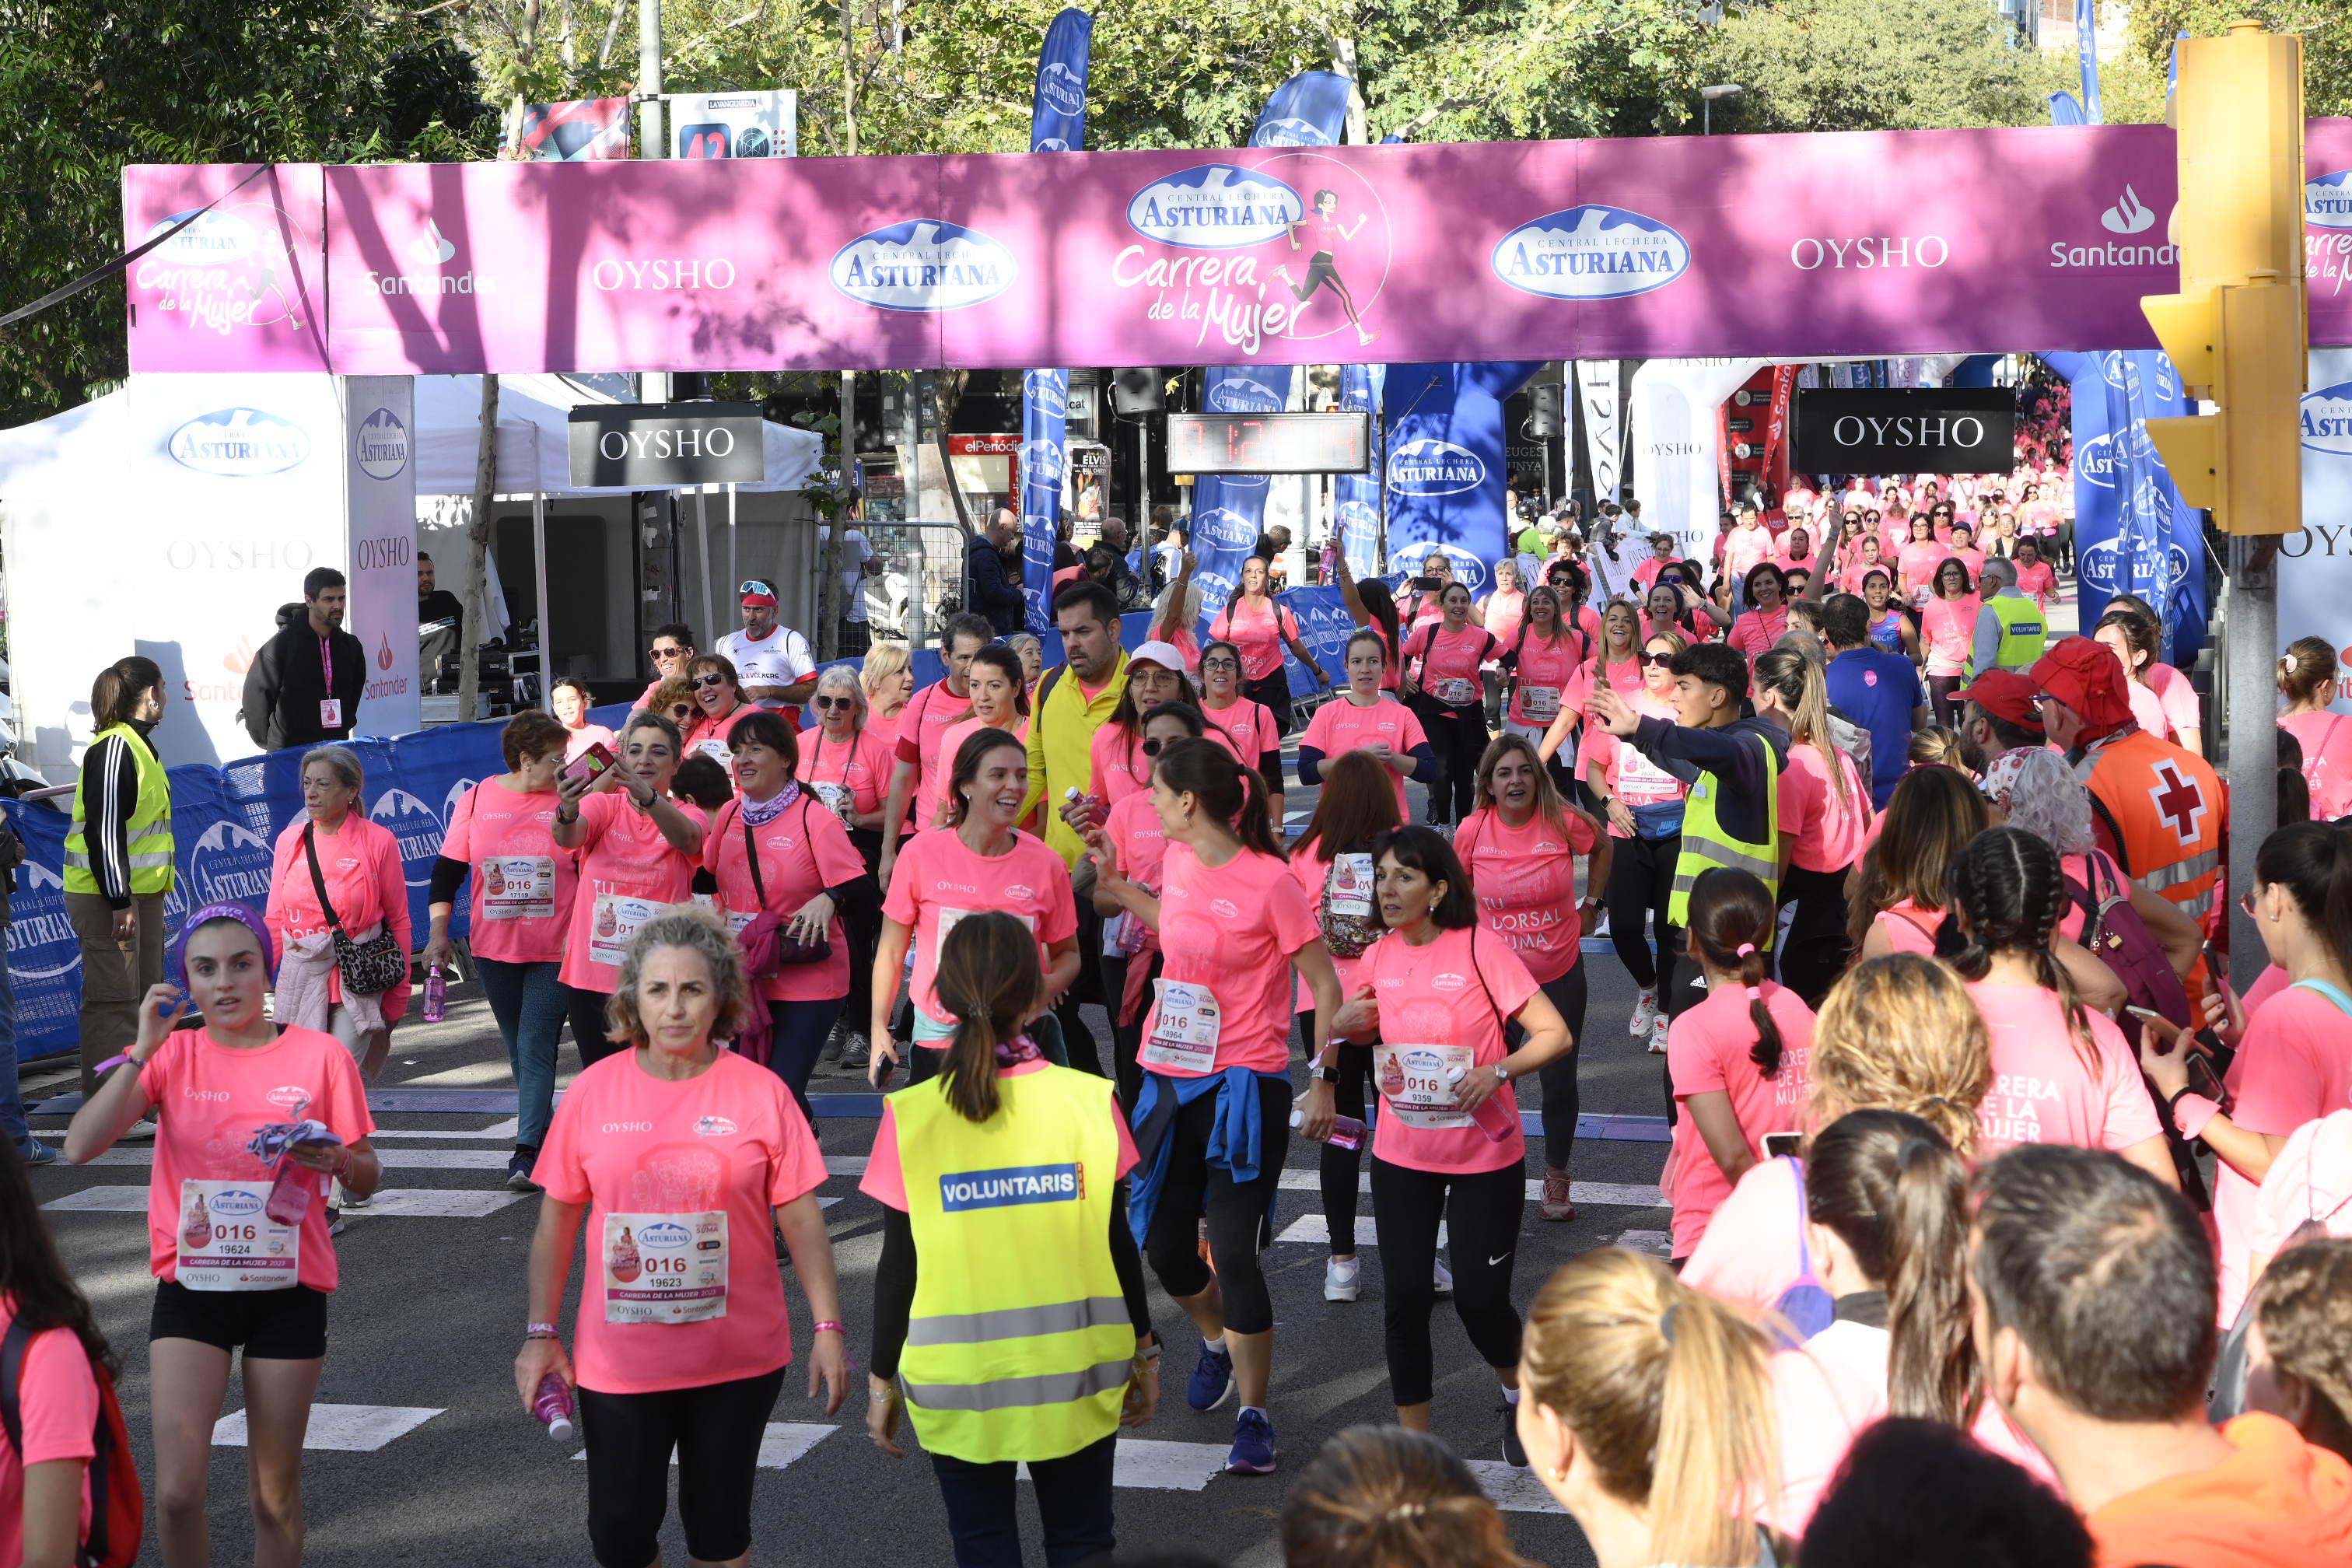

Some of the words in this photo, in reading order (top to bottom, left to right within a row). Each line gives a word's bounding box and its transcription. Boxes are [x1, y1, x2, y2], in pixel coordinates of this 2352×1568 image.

[1167, 193, 1223, 202] CENTRAL
[1229, 192, 1285, 202] LECHERA
[1140, 196, 1290, 228] ASTURIANA
[1538, 238, 1599, 247] CENTRAL
[1605, 236, 1668, 246] LECHERA
[873, 251, 930, 261] CENTRAL
[1507, 241, 1675, 276] ASTURIANA
[1790, 236, 1949, 270] OYSHO
[844, 254, 1001, 289] ASTURIANA
[1112, 244, 1259, 289] Carrera
[2322, 255, 2337, 278] la
[135, 260, 229, 290] Carrera
[593, 258, 736, 291] OYSHO
[365, 269, 497, 296] Santander
[158, 292, 176, 311] de
[179, 290, 192, 312] la
[189, 286, 262, 336] Mujer
[1148, 291, 1175, 320] de
[1181, 294, 1200, 320] la
[1196, 284, 1313, 355] Mujer
[1833, 415, 1984, 448] OYSHO
[360, 434, 405, 463] ASTURIANA
[600, 428, 734, 460] OYSHO
[1642, 442, 1702, 457] OYSHO
[1082, 455, 1106, 465] ELVIS
[1390, 462, 1479, 484] ASTURIANA
[166, 539, 314, 570] OYSHO
[357, 535, 410, 570] OYSHO
[365, 676, 408, 701] Santander
[482, 812, 512, 821] OYSHO
[1659, 820, 1678, 830] NIKE
[1479, 845, 1507, 856] OYSHO
[507, 880, 531, 890] 016
[592, 879, 616, 895] TU
[936, 880, 976, 894] OYSHO
[1482, 897, 1505, 911] TU
[185, 905, 244, 929] Carrera
[1493, 908, 1563, 930] DORSAL
[1162, 1014, 1188, 1029] 016
[1162, 1030, 1183, 1039] 18964
[1179, 1055, 1207, 1065] Santander
[1405, 1057, 1440, 1068] ASTURIANA
[1408, 1077, 1438, 1091] 016
[1776, 1069, 1793, 1088] DE
[184, 1087, 231, 1102] OYSHO
[1412, 1094, 1432, 1103] 9359
[2006, 1097, 2038, 1121] LA
[1437, 1113, 1468, 1122] Santander
[602, 1121, 653, 1133] OYSHO
[943, 1173, 1075, 1202] VOLUNTARIS
[212, 1200, 259, 1209] ASTURIANA
[215, 1224, 257, 1241] 016
[696, 1225, 719, 1234] SUMA
[642, 1233, 689, 1243] ASTURIANA
[219, 1245, 250, 1255] 19624
[645, 1257, 687, 1273] 016
[186, 1272, 221, 1283] OYSHO
[249, 1274, 289, 1283] Santander
[649, 1278, 682, 1288] 19623
[674, 1290, 698, 1299] MUJER
[617, 1305, 653, 1316] OYSHO
[683, 1303, 718, 1314] Santander
